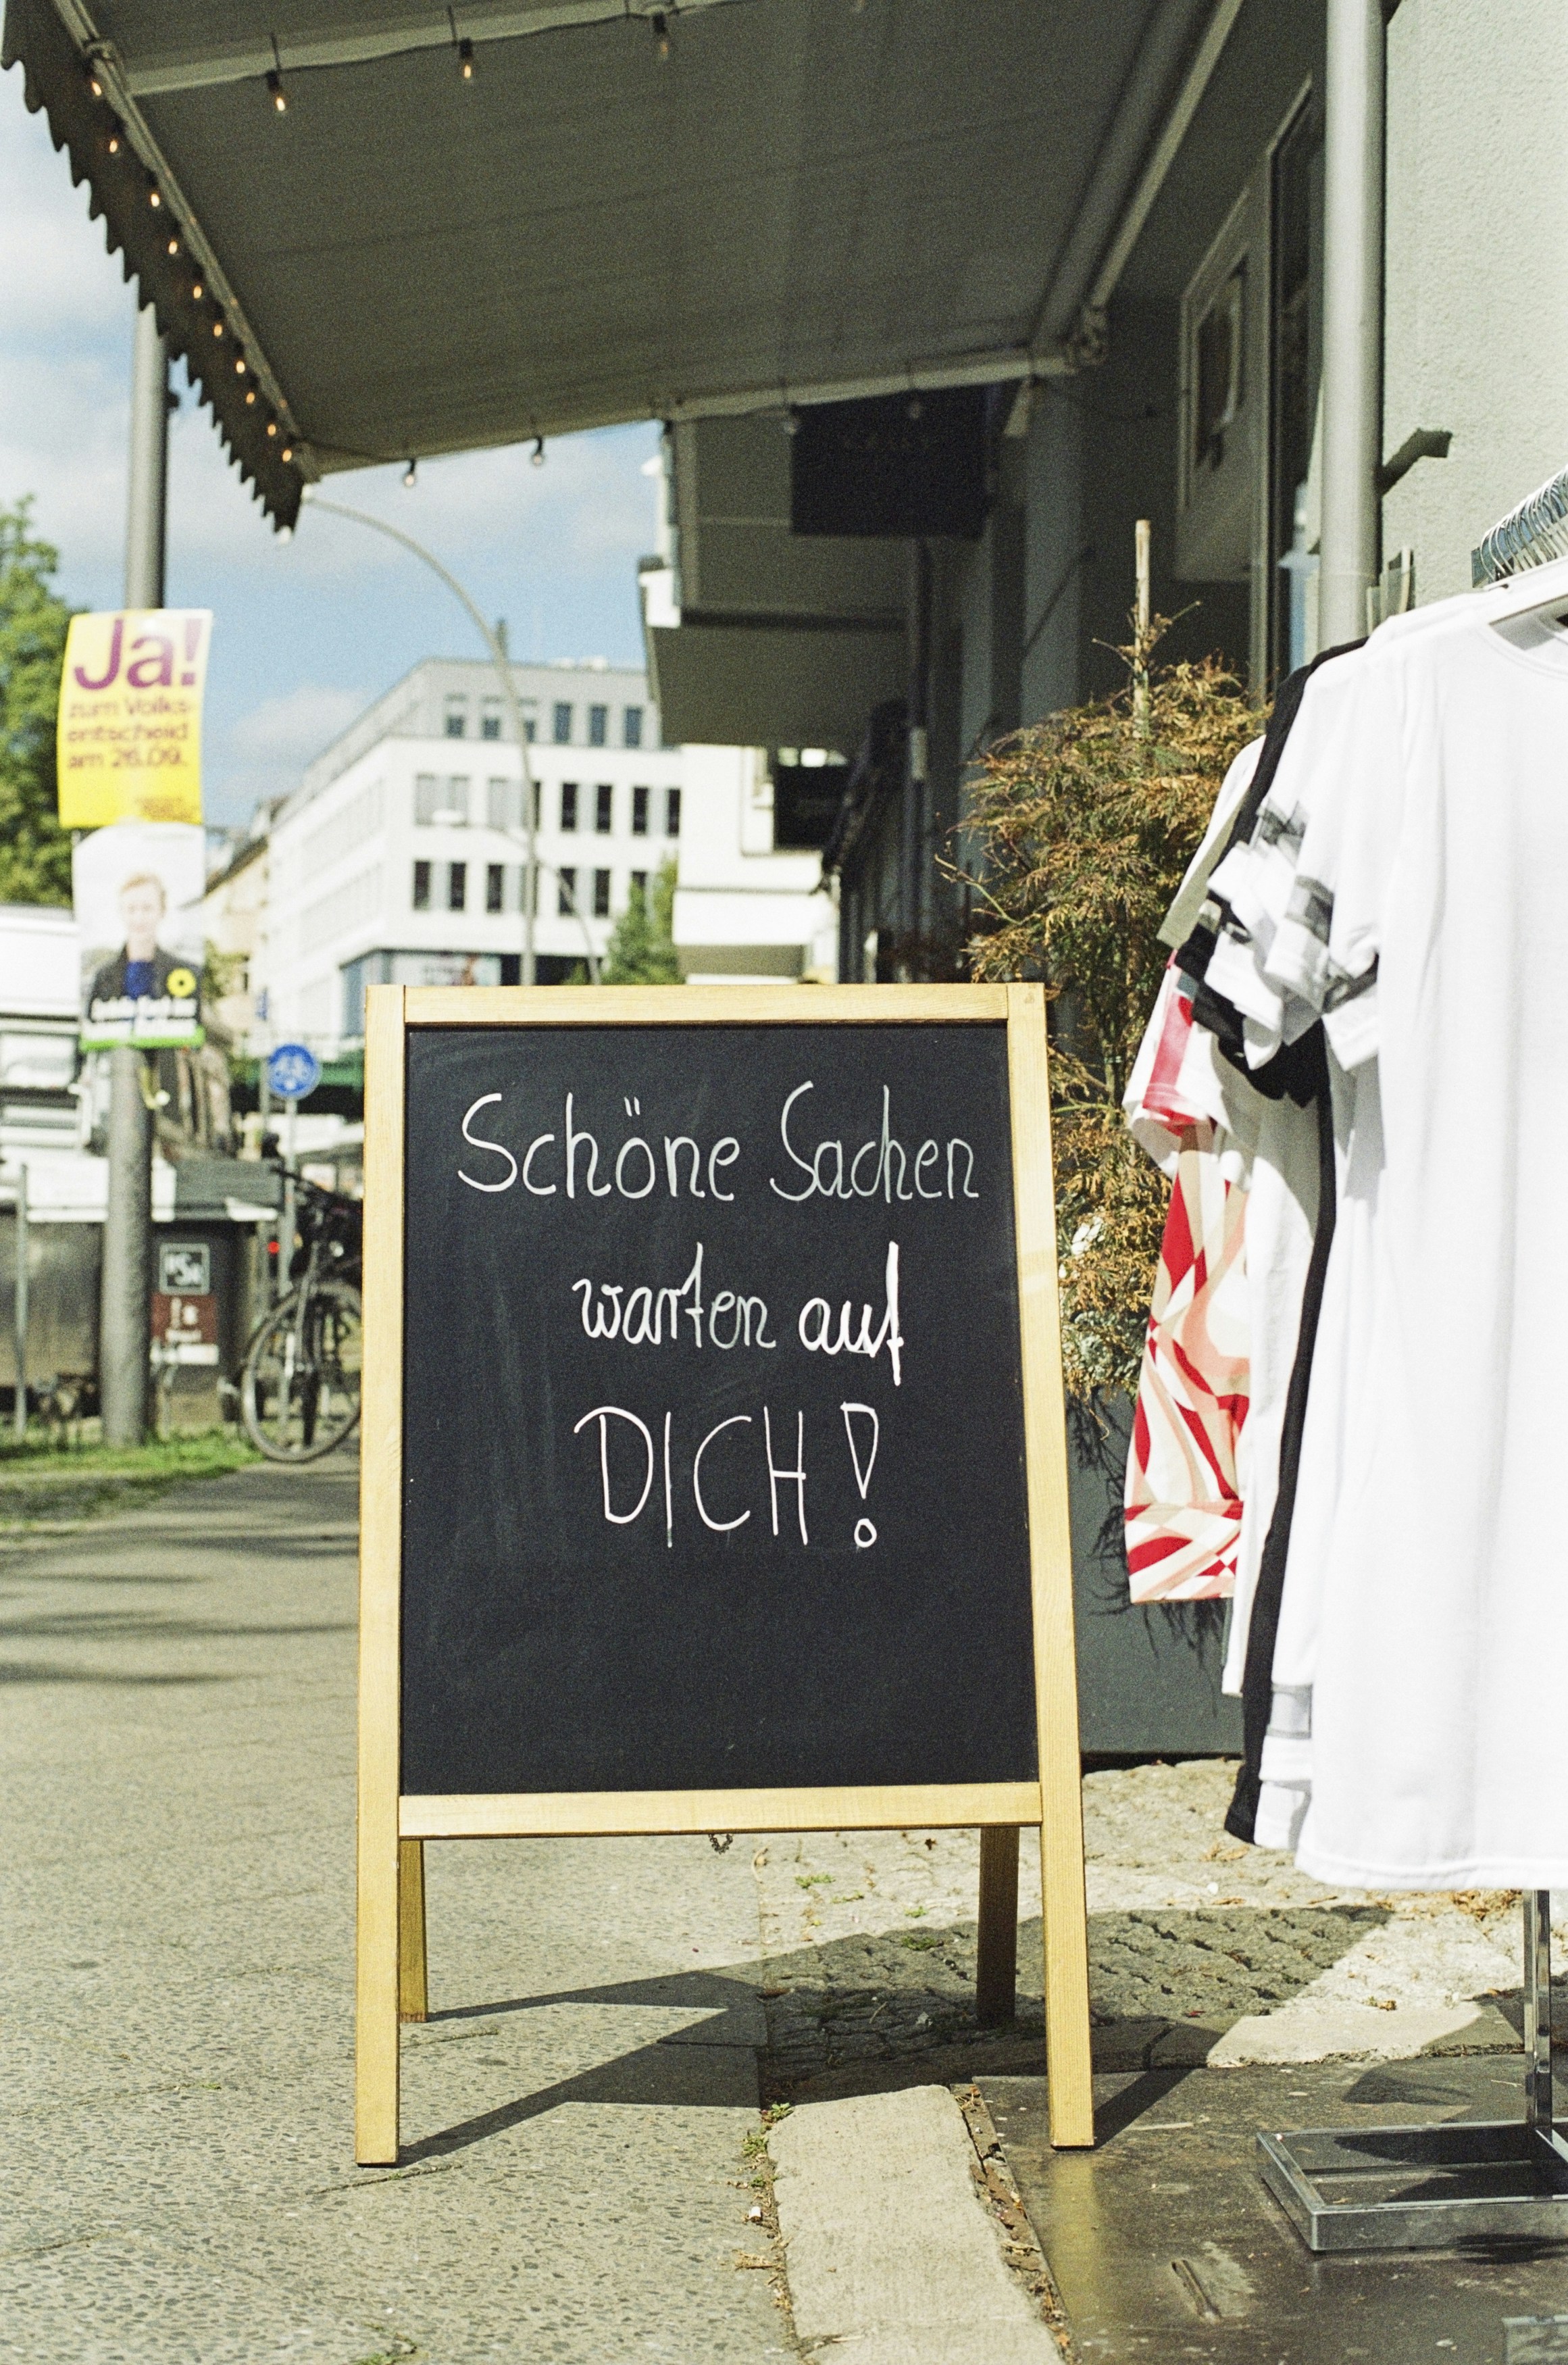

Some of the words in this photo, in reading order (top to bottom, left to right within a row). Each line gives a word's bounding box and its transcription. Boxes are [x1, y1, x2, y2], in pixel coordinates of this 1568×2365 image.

[74, 618, 201, 691] Ja!
[457, 1091, 741, 1202] Schöne
[769, 1080, 980, 1204] Sachen
[571, 1241, 778, 1350] warten
[797, 1240, 905, 1387] auf
